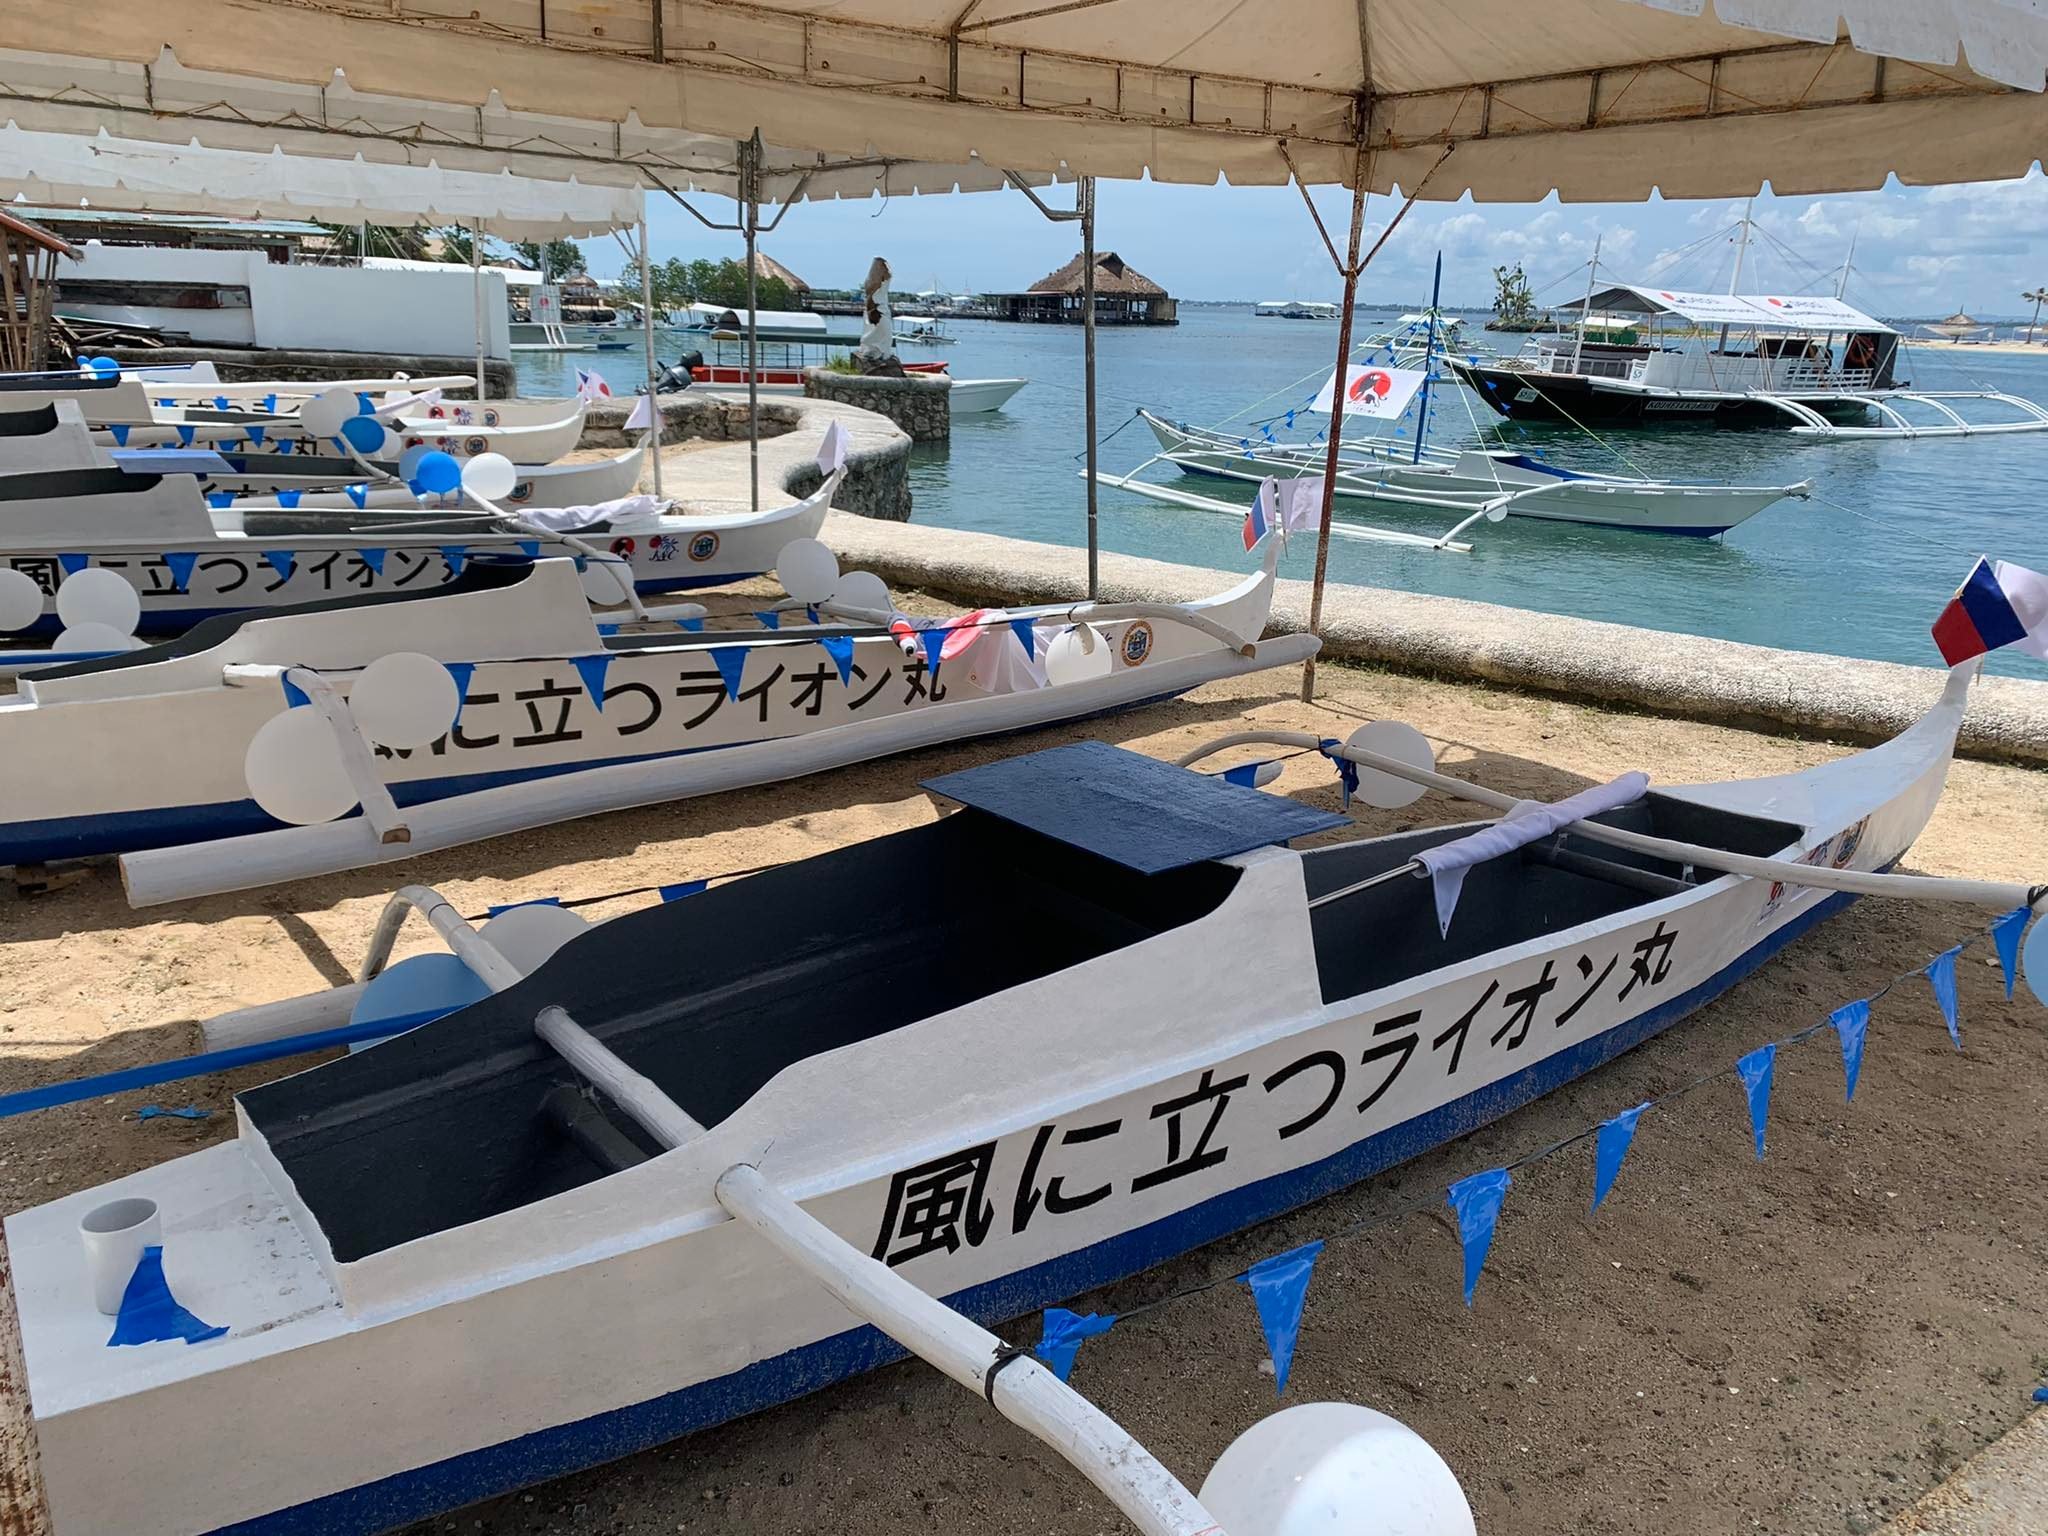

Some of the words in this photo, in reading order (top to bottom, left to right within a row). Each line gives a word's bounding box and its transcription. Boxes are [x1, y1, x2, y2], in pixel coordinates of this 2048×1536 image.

[373, 659, 947, 759] に立つライオン丸
[873, 922, 1678, 1267] 風に立つライオン丸
